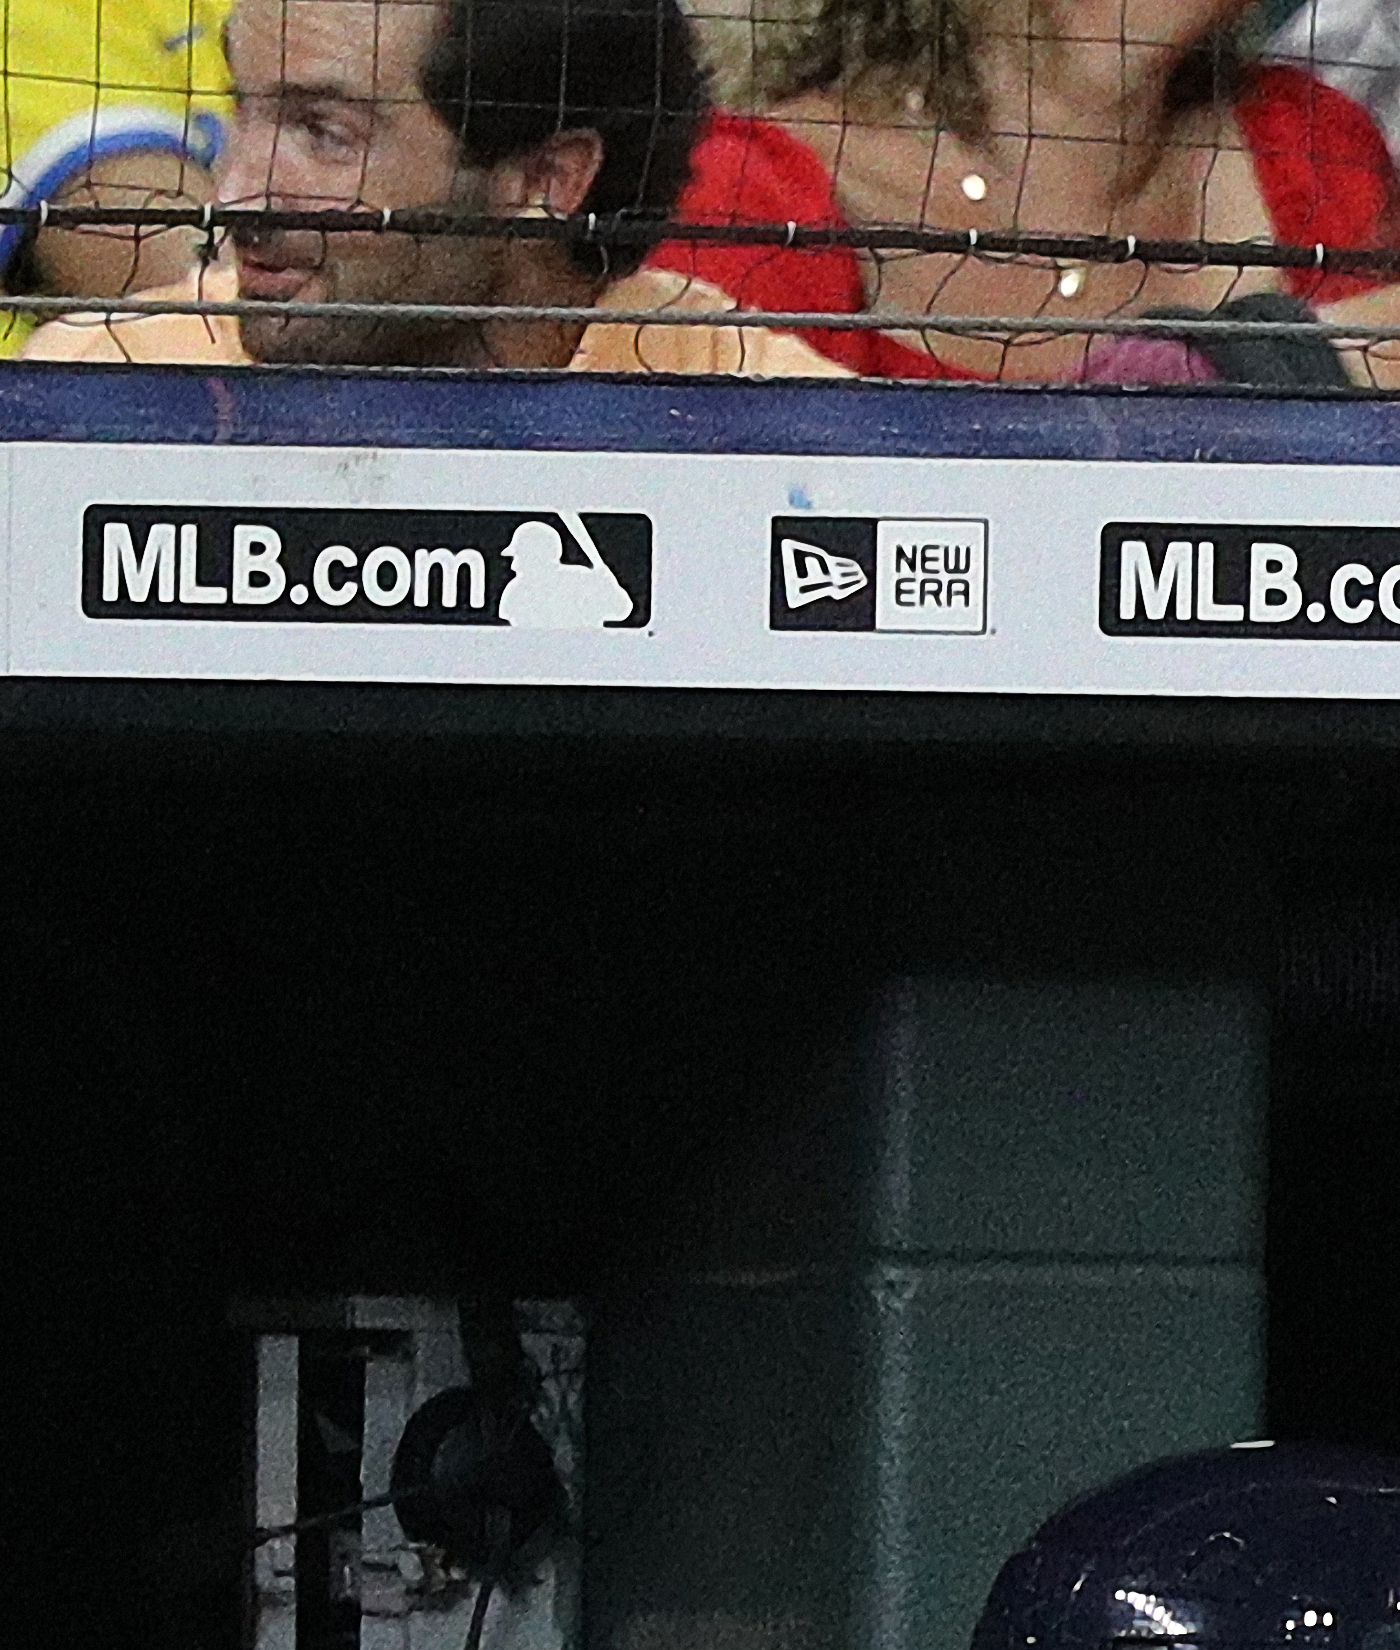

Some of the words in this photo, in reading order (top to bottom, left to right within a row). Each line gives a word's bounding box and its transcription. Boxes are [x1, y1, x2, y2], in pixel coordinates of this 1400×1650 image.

[103, 522, 485, 609] MLB.com
[895, 544, 971, 575] NEW
[894, 577, 970, 608] ERA
